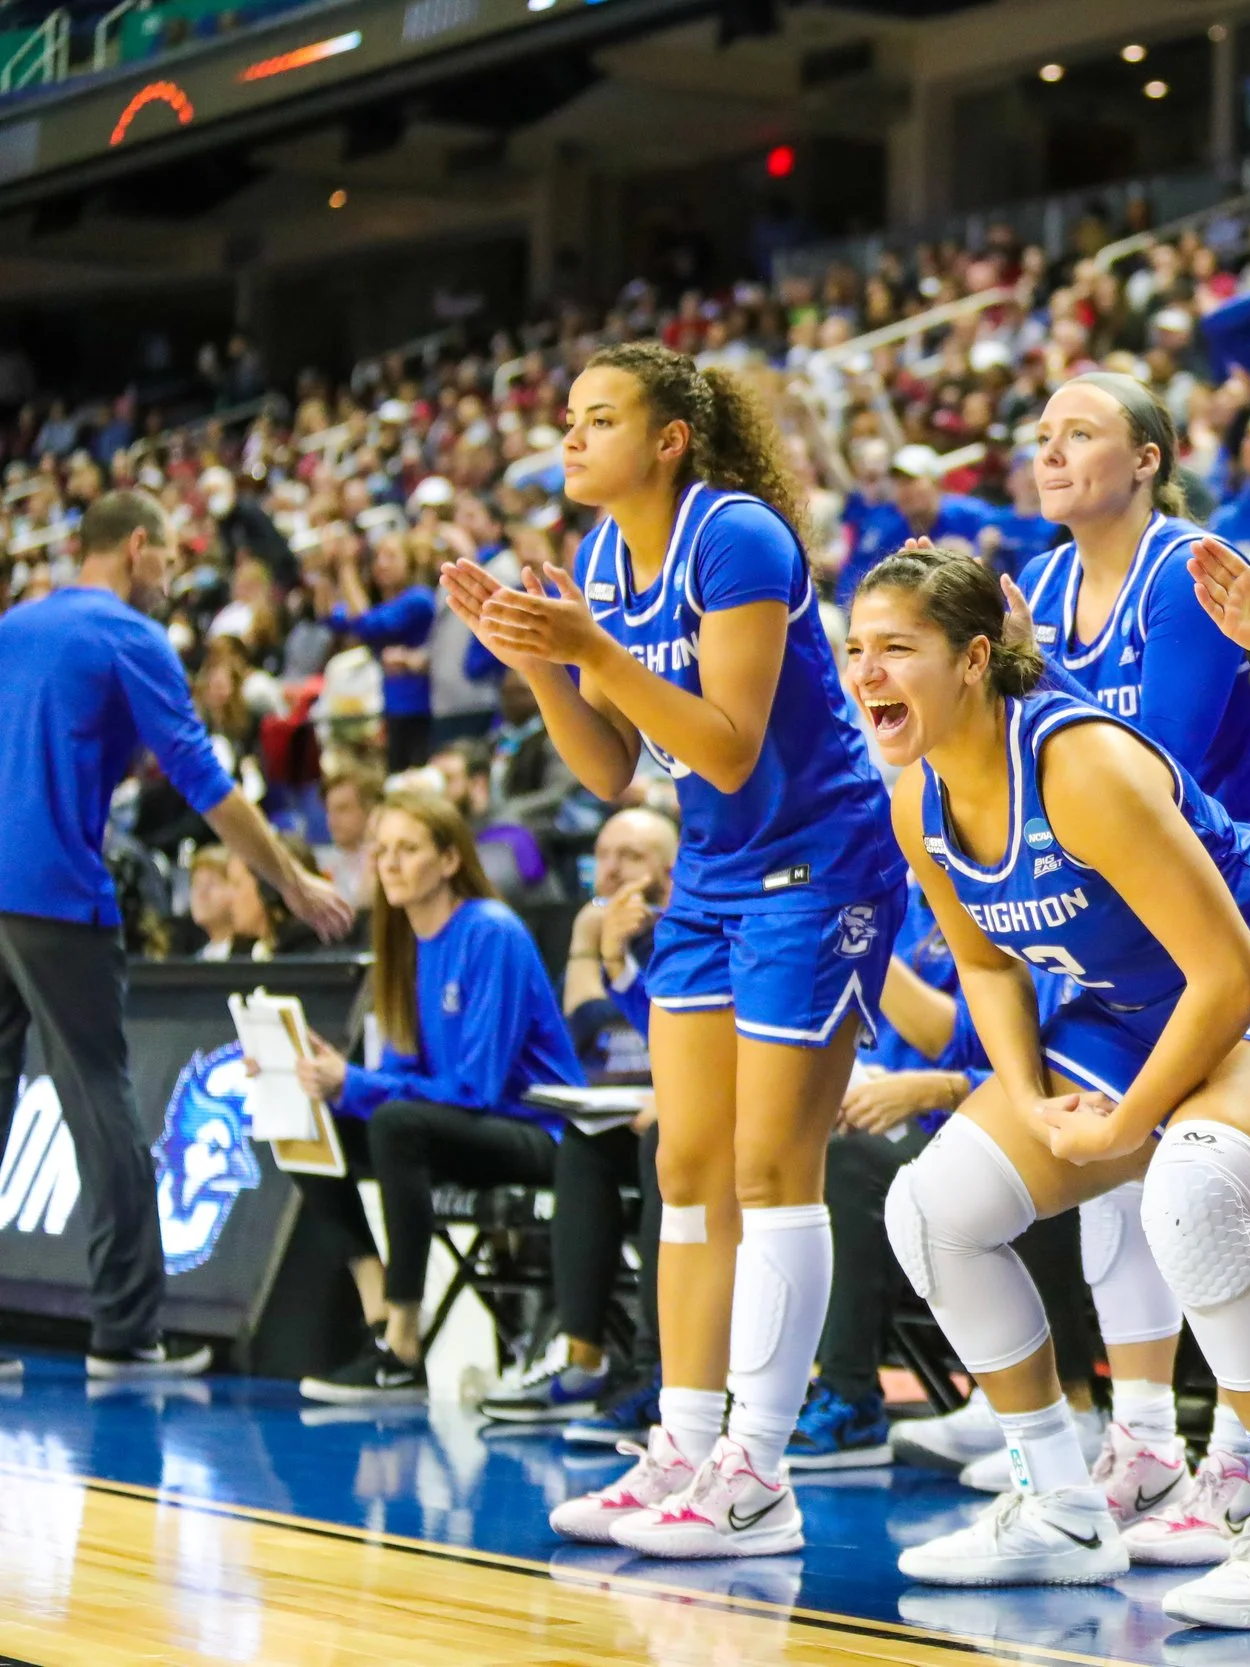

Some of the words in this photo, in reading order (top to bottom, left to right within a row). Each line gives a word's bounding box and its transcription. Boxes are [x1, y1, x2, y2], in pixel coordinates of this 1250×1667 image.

[1028, 831, 1053, 842] NCAA
[1034, 854, 1055, 867] BIG
[795, 868, 804, 879] M
[1034, 859, 1063, 876] EAST
[960, 887, 1089, 933] EIGHTON
